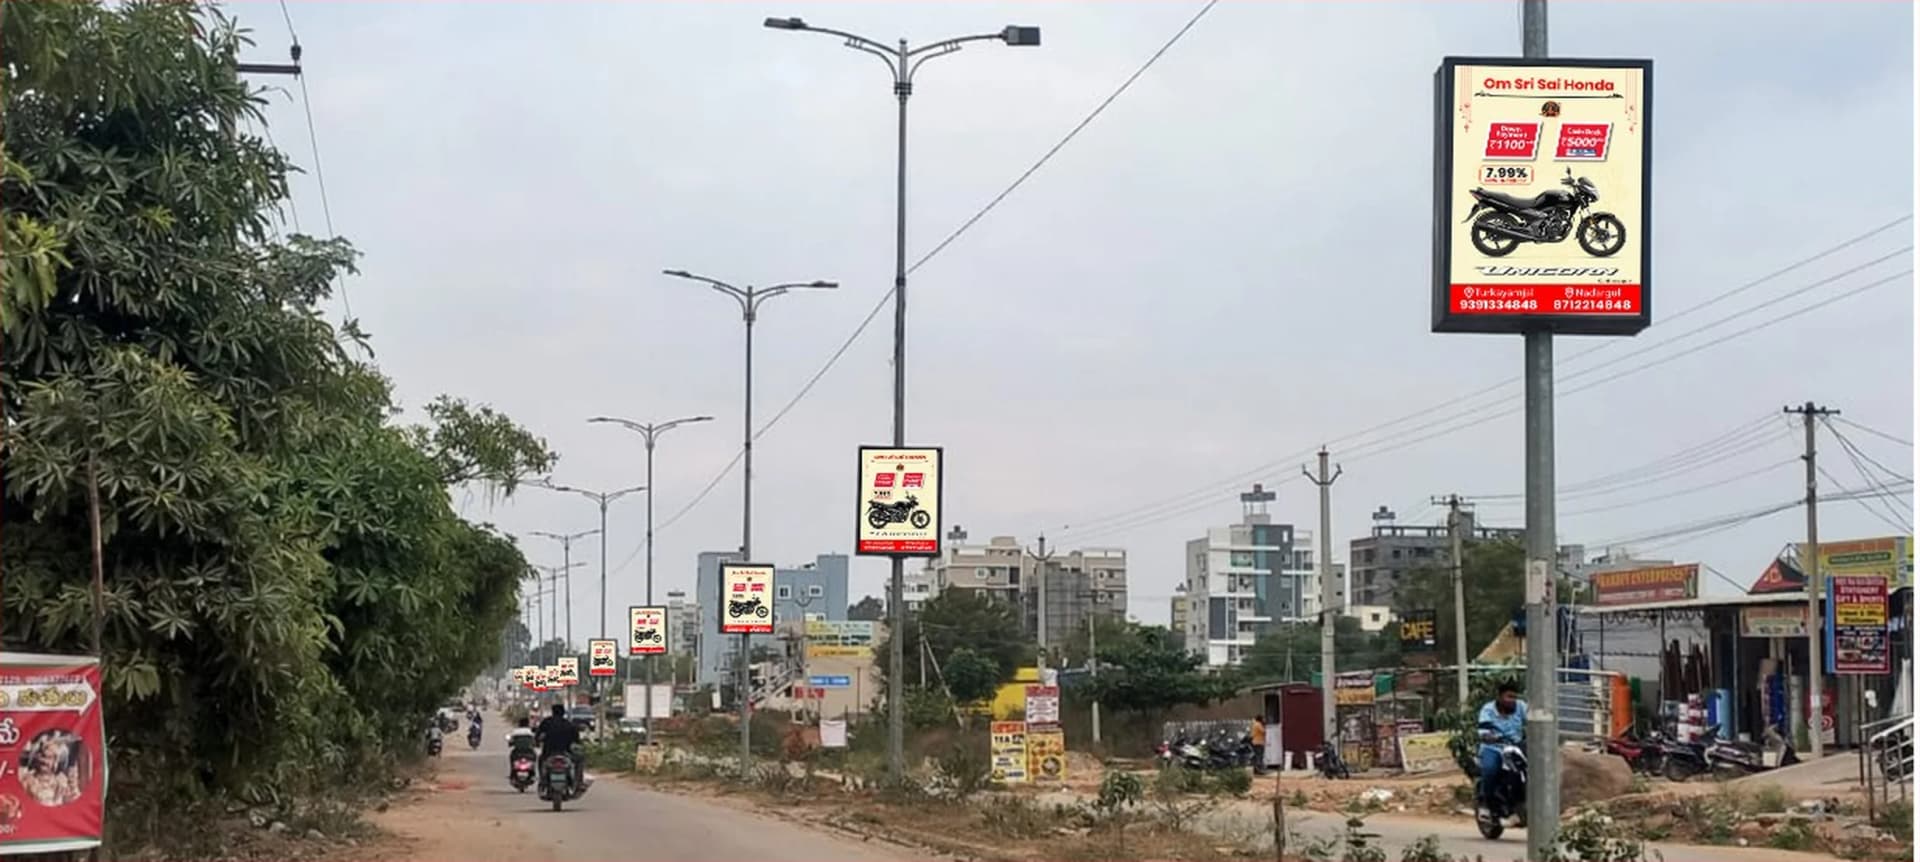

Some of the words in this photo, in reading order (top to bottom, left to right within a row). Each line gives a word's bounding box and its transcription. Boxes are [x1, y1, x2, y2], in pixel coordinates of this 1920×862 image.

[1484, 78, 1511, 90] Om
[1514, 77, 1534, 90] Sri
[1538, 78, 1561, 90] Sai
[1564, 78, 1614, 91] Honda
[1486, 167, 1528, 178] 7.99%
[1460, 300, 1538, 310] 9391334848
[1553, 300, 1632, 310] 8712214848
[1401, 621, 1433, 640] CAFE
